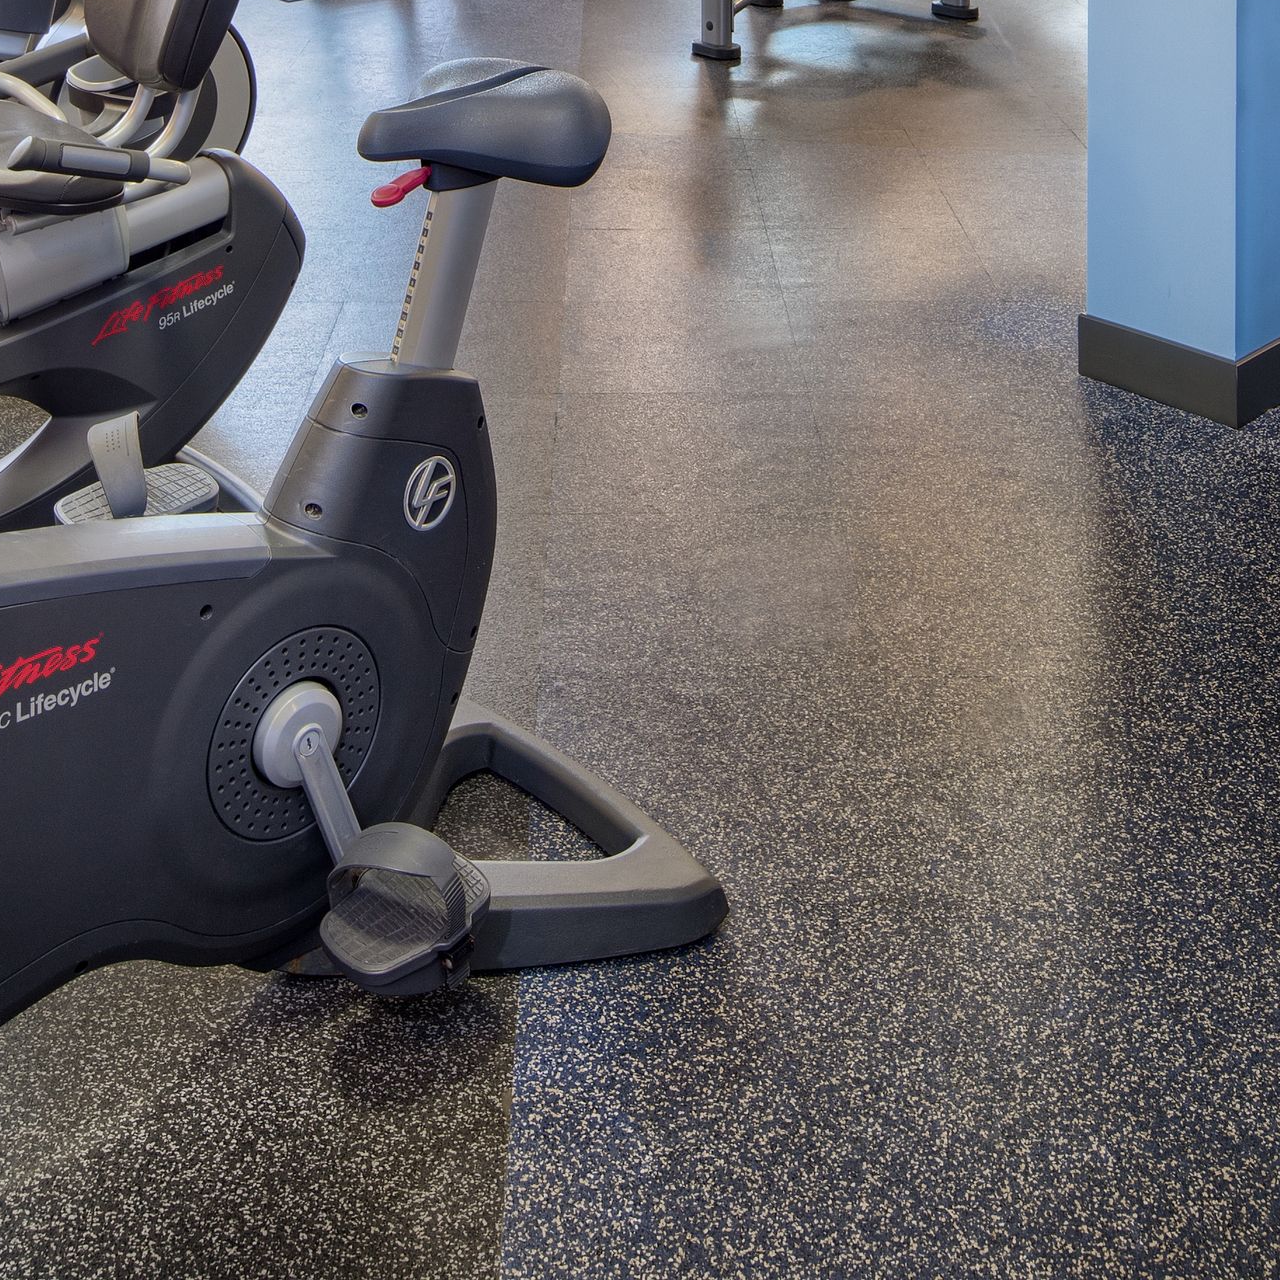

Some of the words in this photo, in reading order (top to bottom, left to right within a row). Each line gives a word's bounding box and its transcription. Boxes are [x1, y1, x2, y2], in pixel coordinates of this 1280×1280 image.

[91, 300, 145, 347] Life
[143, 265, 224, 324] Fitness
[182, 282, 234, 319] Lifecycle
[16, 671, 113, 723] Lifecycle
